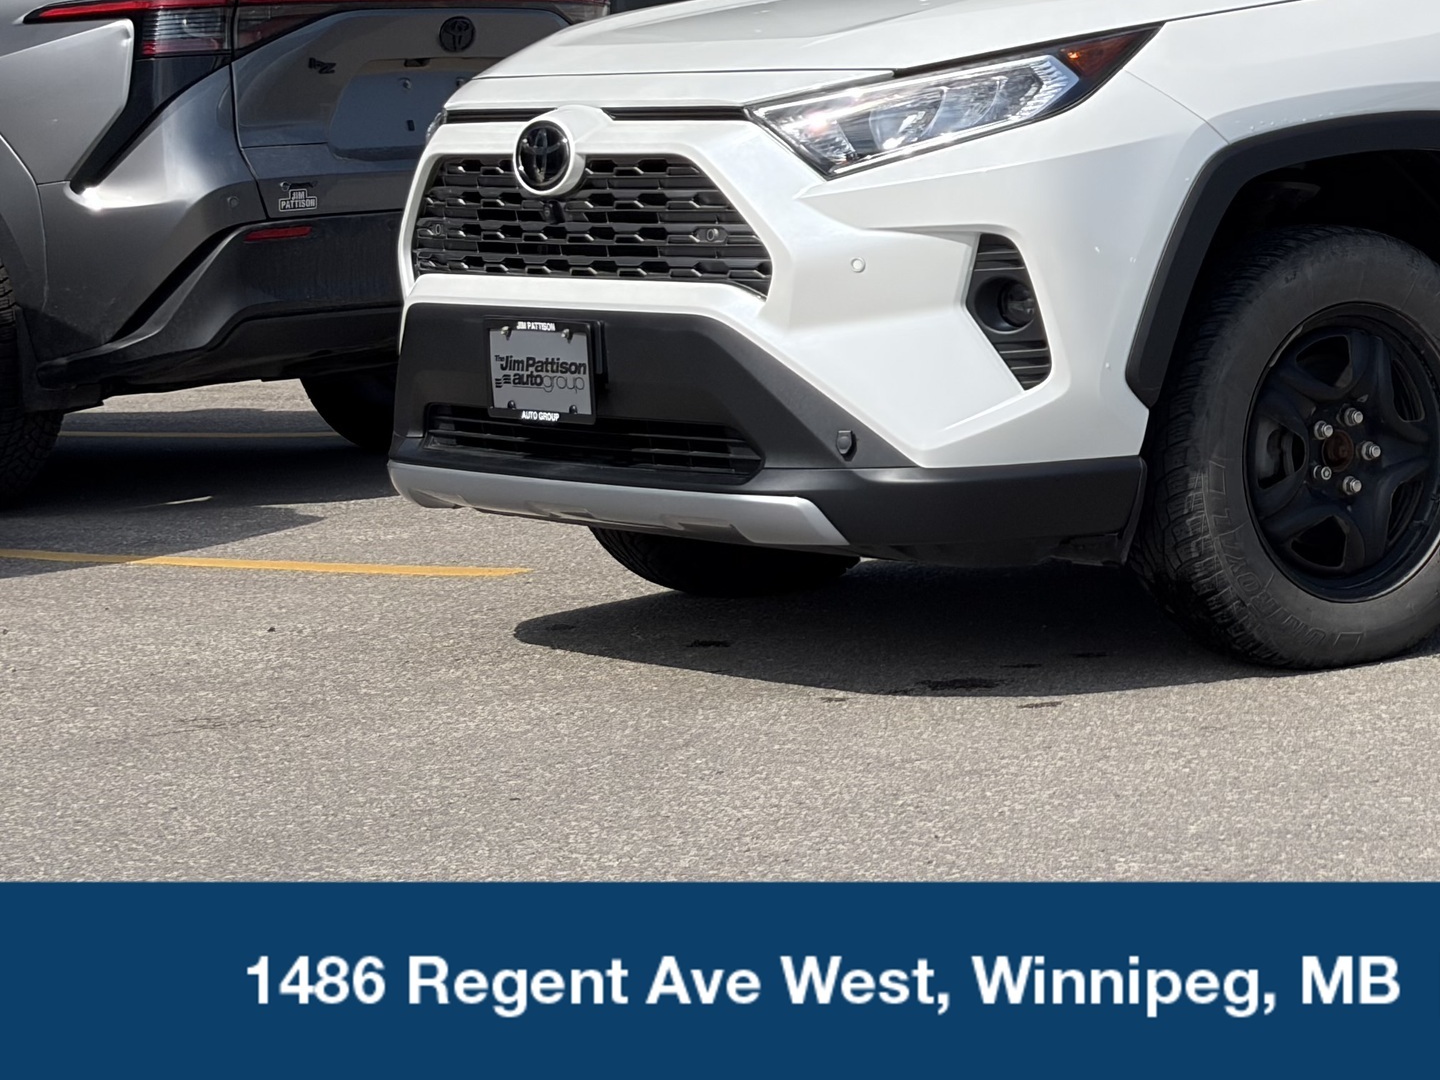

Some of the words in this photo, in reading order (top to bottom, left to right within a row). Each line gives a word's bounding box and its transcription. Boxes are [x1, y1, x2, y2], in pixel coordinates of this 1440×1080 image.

[292, 191, 305, 200] JIM
[281, 199, 316, 209] PATTISON
[516, 321, 527, 330] JIM
[527, 321, 556, 332] PATTISON
[521, 410, 538, 420] AUTO
[538, 411, 560, 422] GROUP
